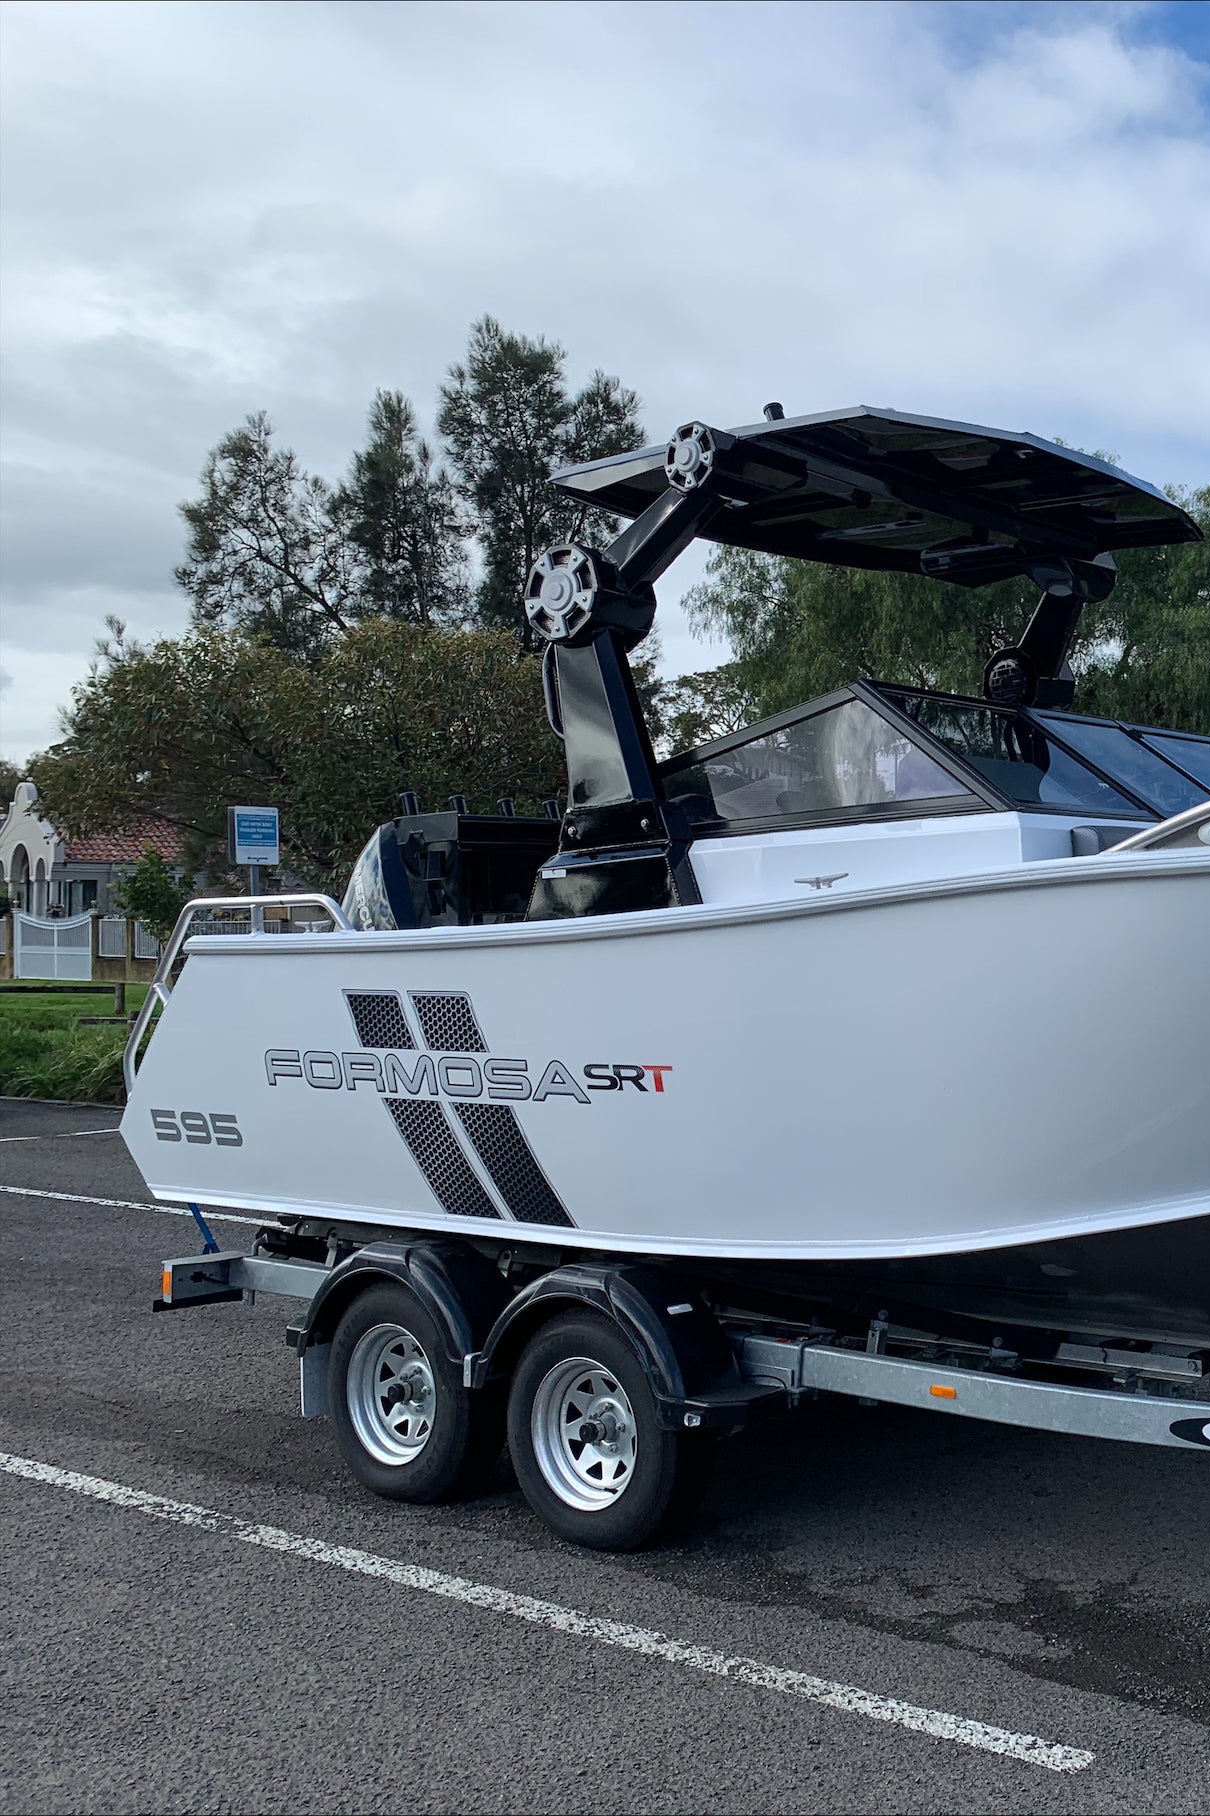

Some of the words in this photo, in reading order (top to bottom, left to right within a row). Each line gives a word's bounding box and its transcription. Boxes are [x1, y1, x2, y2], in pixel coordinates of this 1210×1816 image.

[264, 1048, 592, 1105] FORMOSA
[583, 1063, 673, 1093] SRT
[150, 1108, 243, 1147] 595
